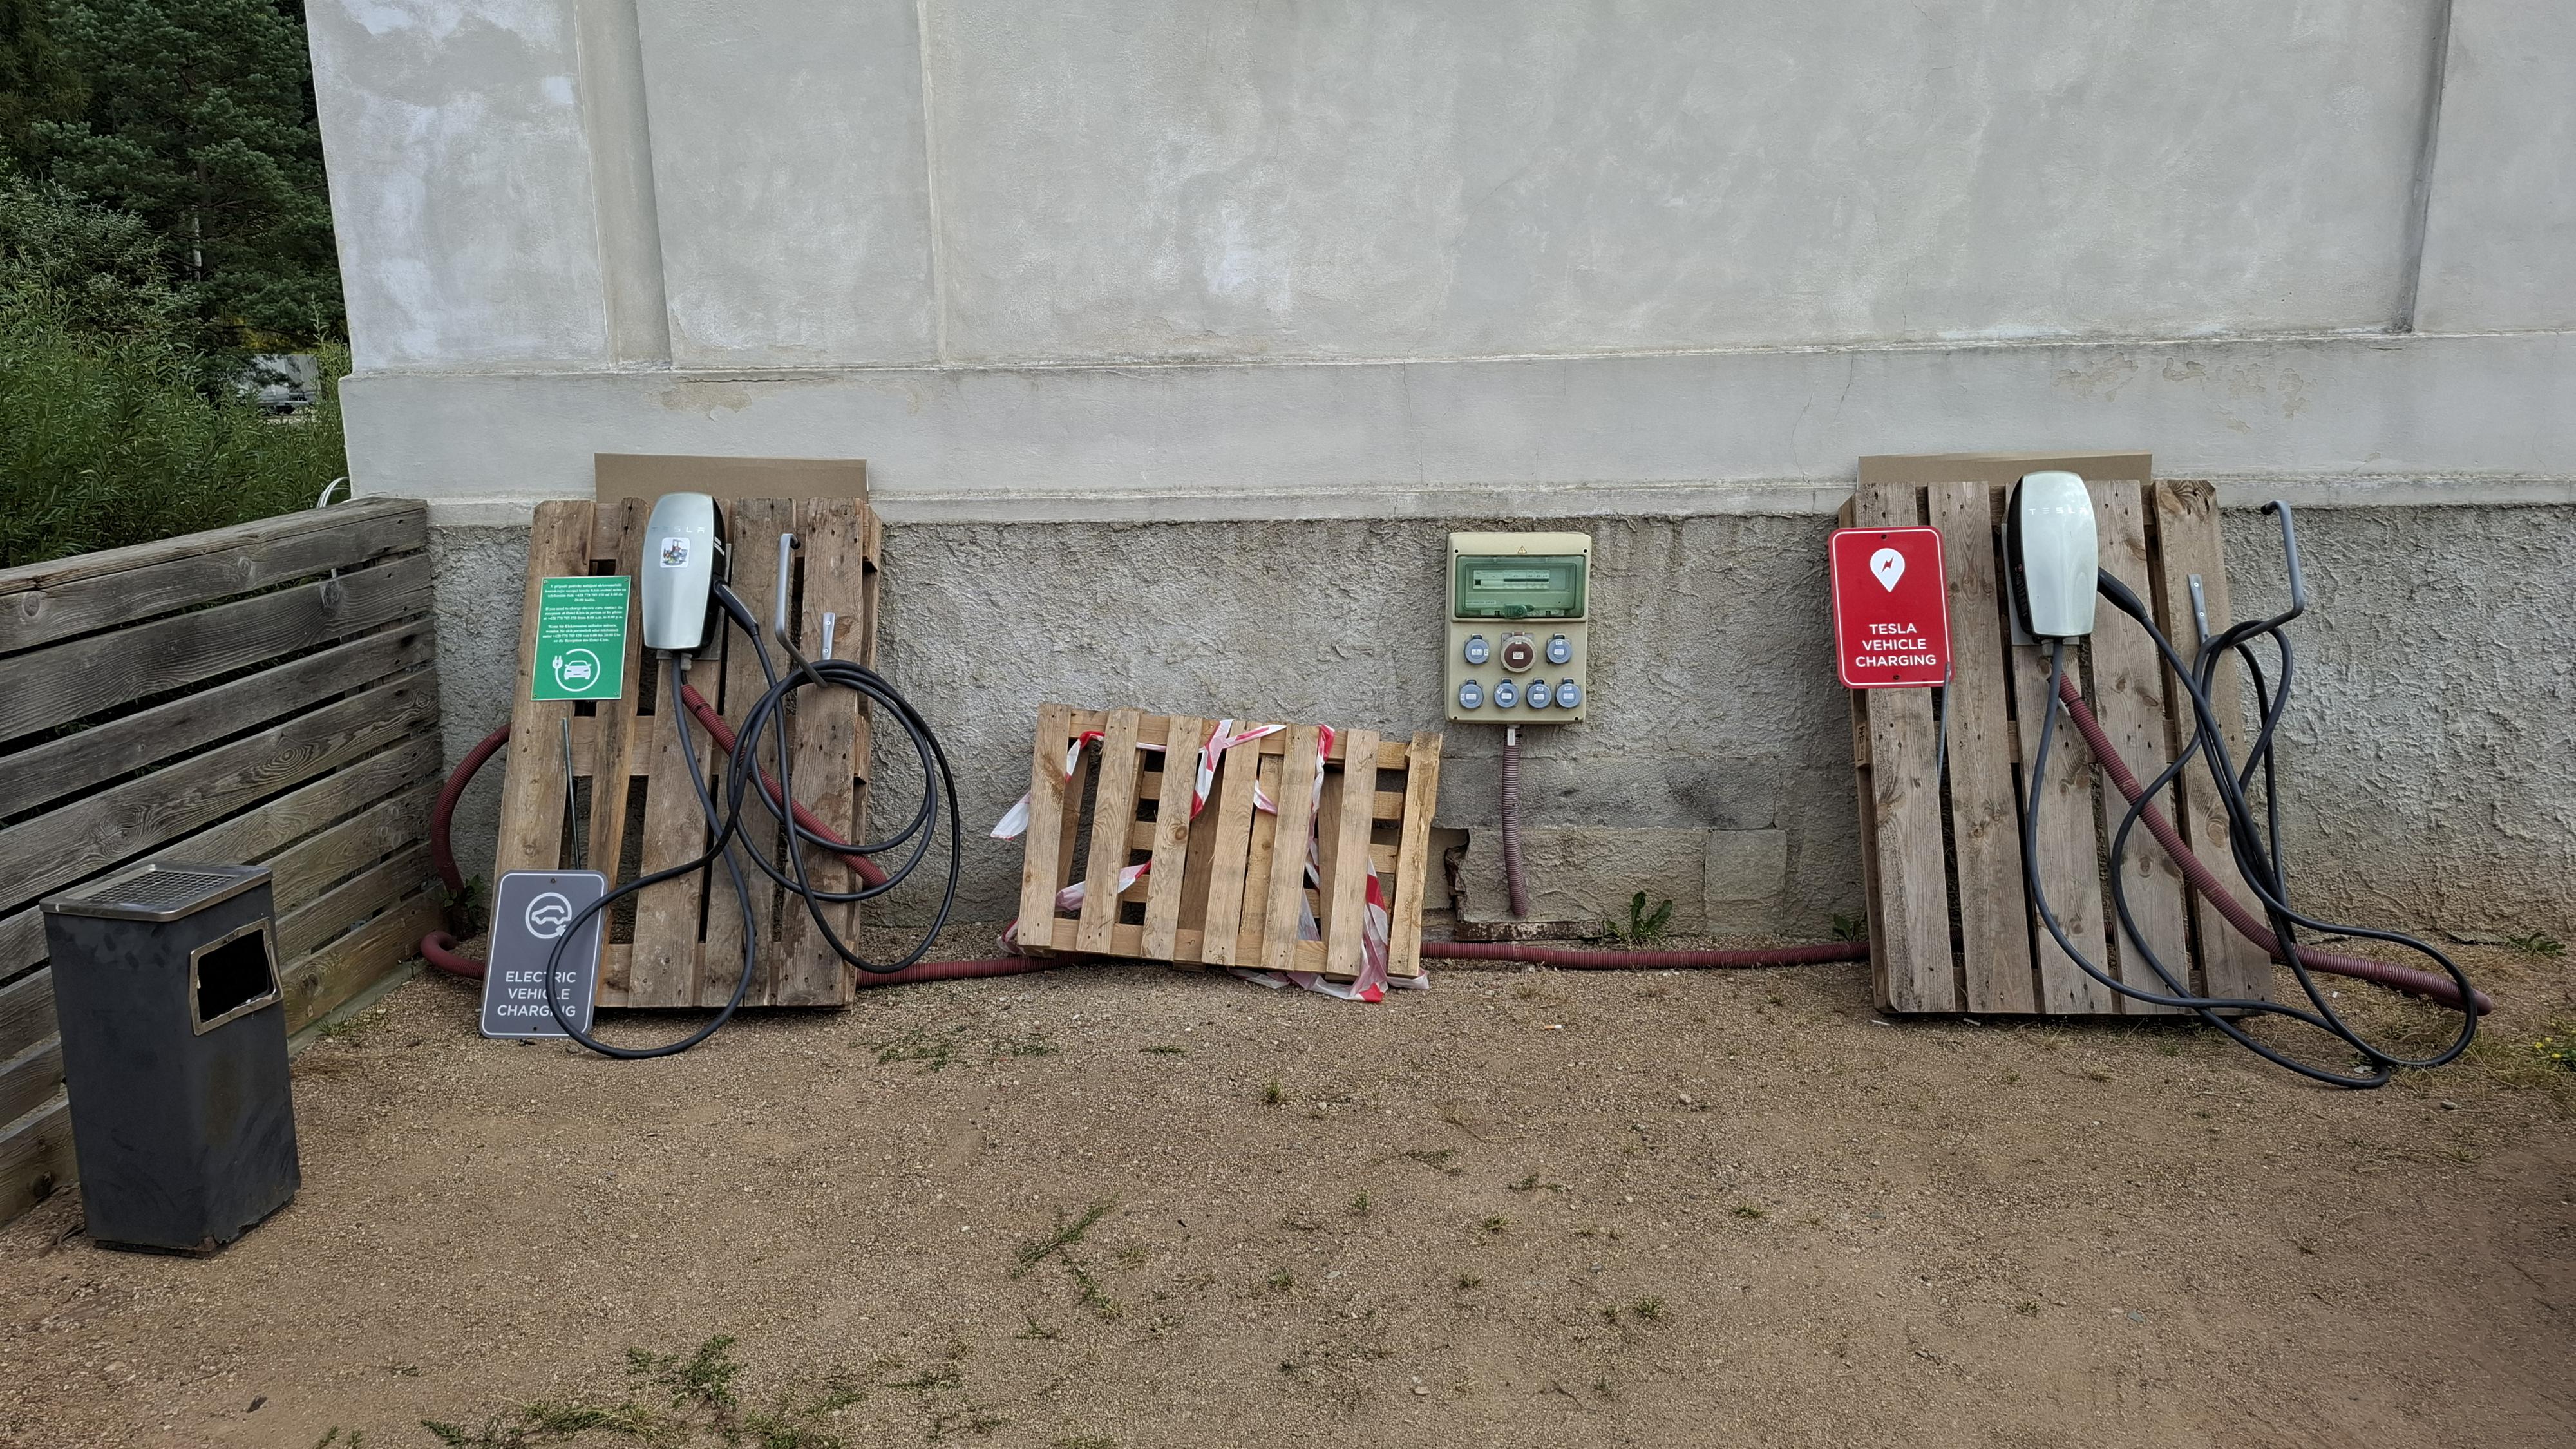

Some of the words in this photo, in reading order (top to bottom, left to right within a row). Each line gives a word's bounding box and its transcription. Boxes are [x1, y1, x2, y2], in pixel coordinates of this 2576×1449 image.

[2029, 506, 2089, 515] TESLA
[1869, 623, 1917, 635] TESLA
[1862, 638, 1927, 651] VEHICLE
[1855, 654, 1937, 667] CHARGING
[506, 971, 576, 983] ELECRIC
[497, 1005, 576, 1017] CHARGG
